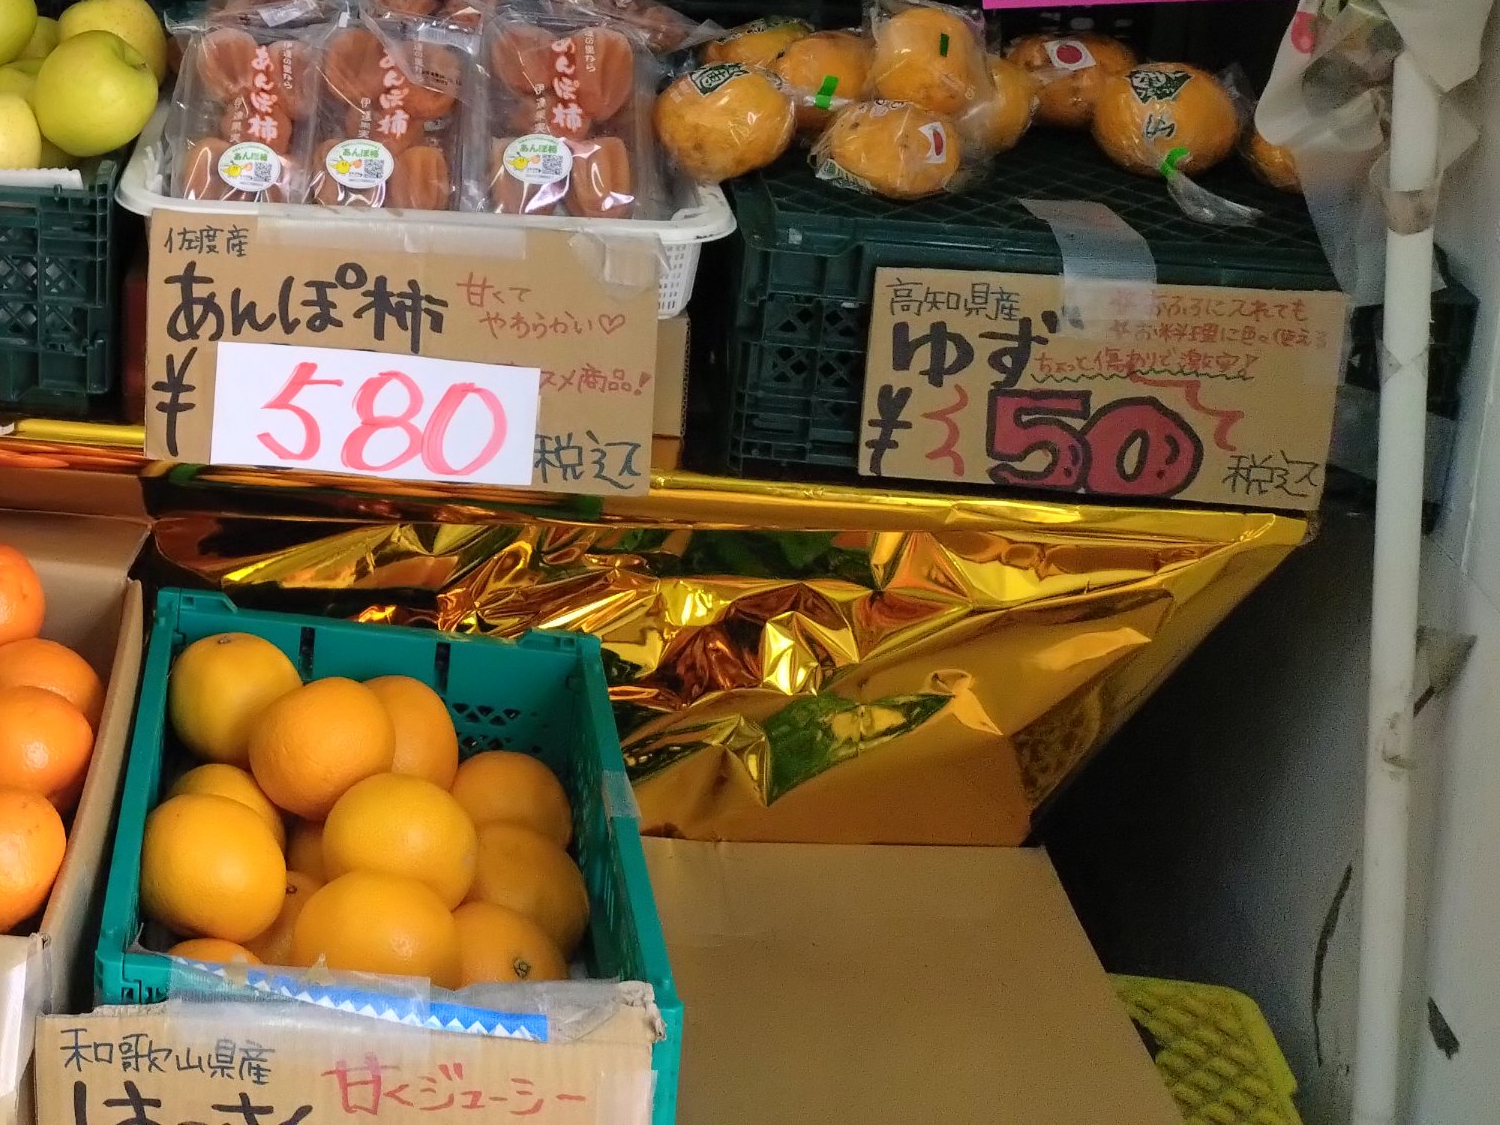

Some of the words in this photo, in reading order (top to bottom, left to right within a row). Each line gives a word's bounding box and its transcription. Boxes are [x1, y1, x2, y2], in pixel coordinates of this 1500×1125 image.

[247, 45, 279, 144] あんぽ柿
[164, 260, 449, 354] あんぽ柿
[456, 271, 533, 311] 甘くて
[885, 278, 1022, 322] 高知県産
[480, 310, 596, 342] やわらかい
[892, 306, 1085, 389] ゆず
[257, 362, 509, 475] 580
[986, 388, 1203, 498] 50
[534, 431, 642, 489] 税込
[1222, 450, 1321, 499] 税込
[60, 1027, 277, 1085] 和歌山県産
[323, 1052, 589, 1117] 甘くジューシー
